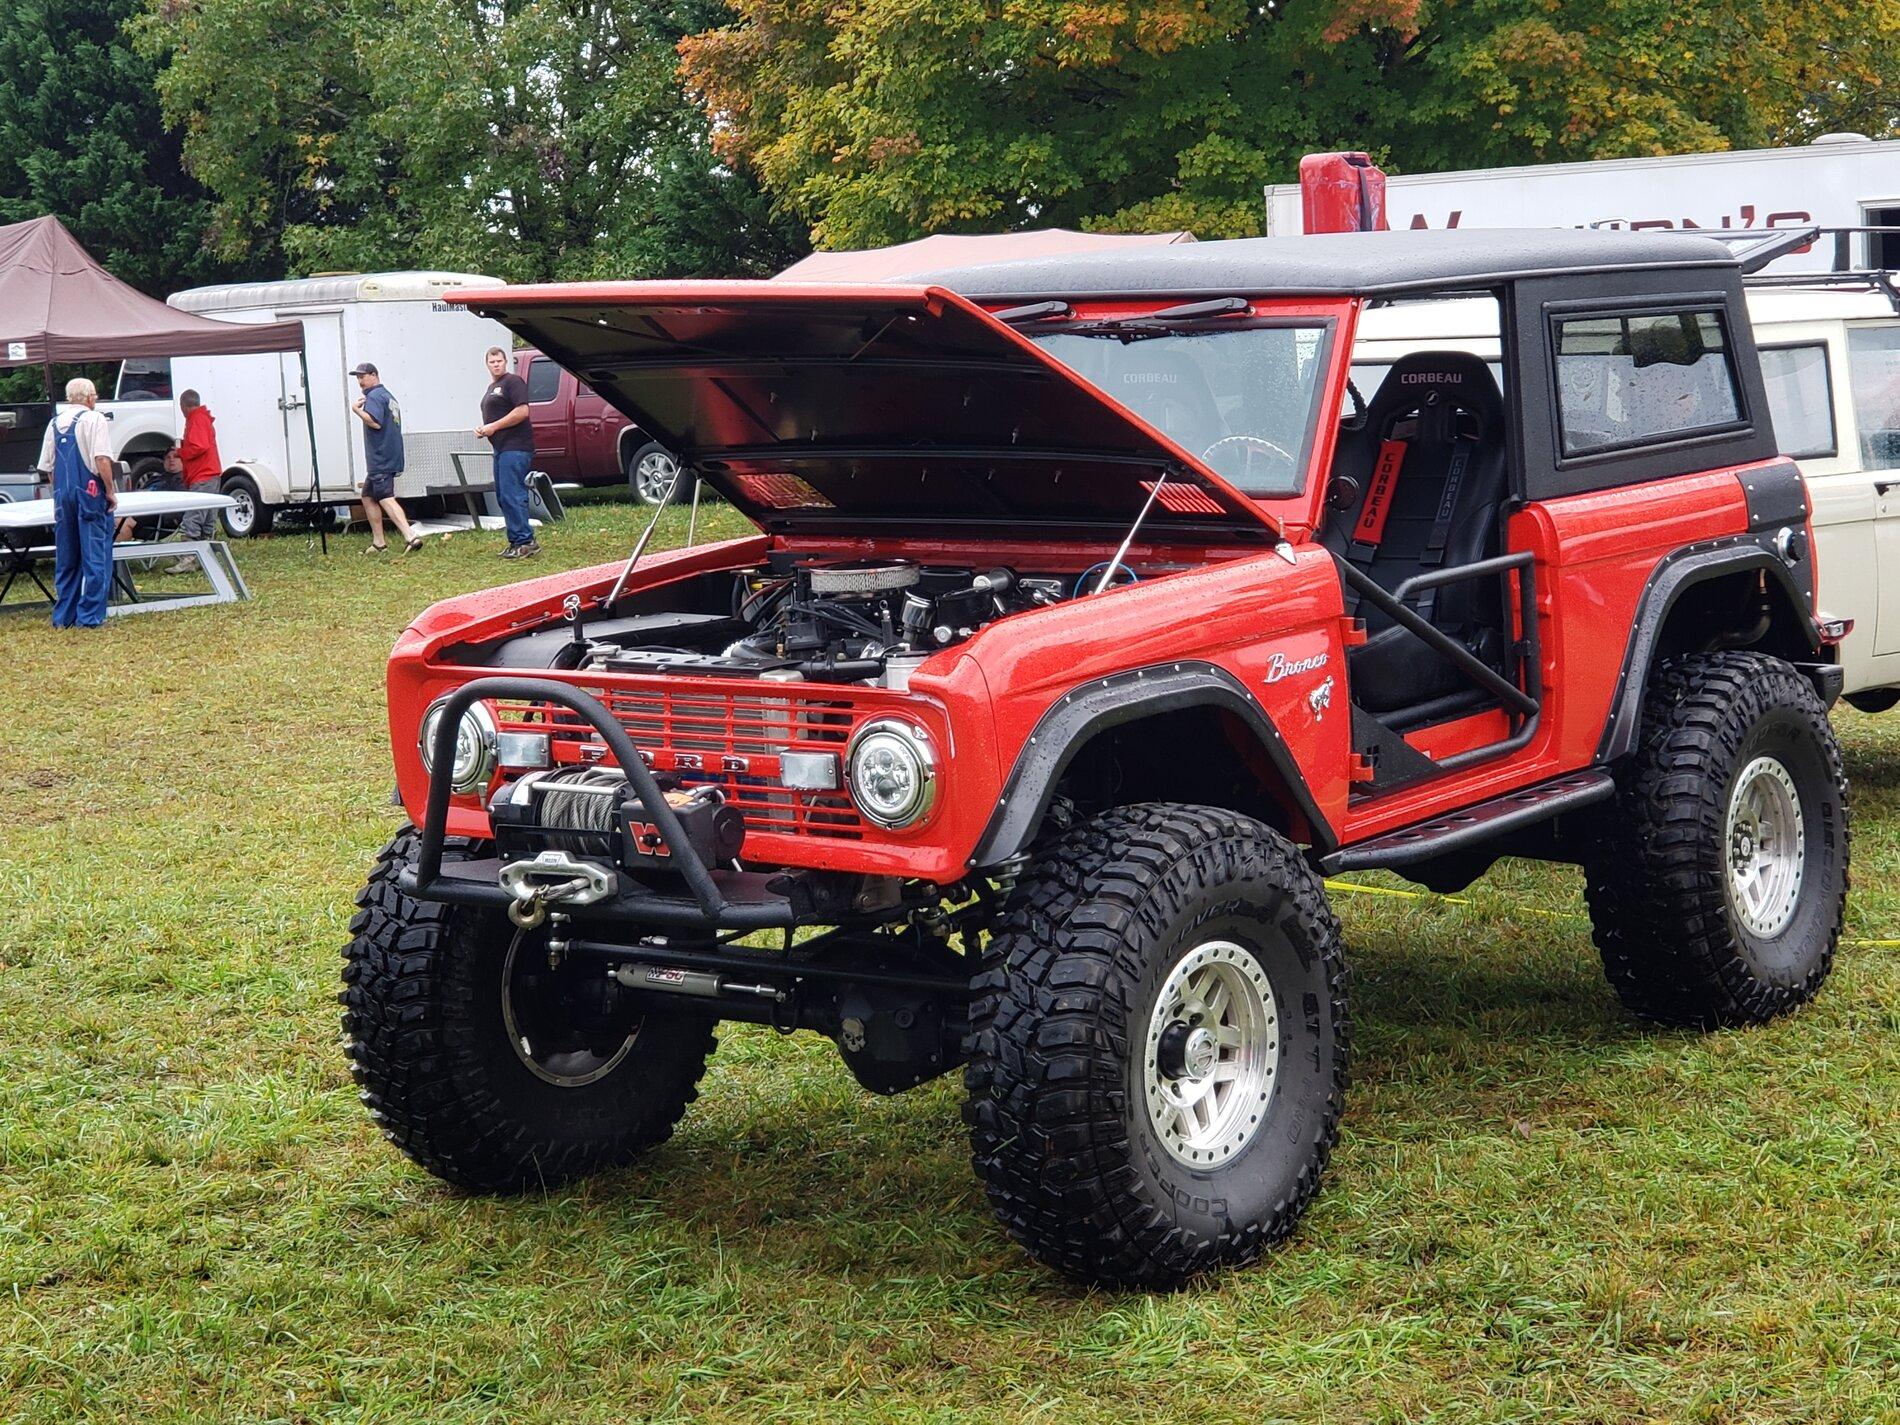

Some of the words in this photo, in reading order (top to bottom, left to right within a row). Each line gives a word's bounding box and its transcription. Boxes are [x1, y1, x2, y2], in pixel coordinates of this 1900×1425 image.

[1123, 373, 1177, 384] CORBEAU
[1401, 373, 1462, 384] CORBEAU
[1363, 453, 1395, 528] CORBEAU
[1441, 458, 1463, 517] CORBEAU
[1262, 652, 1330, 683] Bronco
[1139, 1132, 1228, 1217] COOPER
